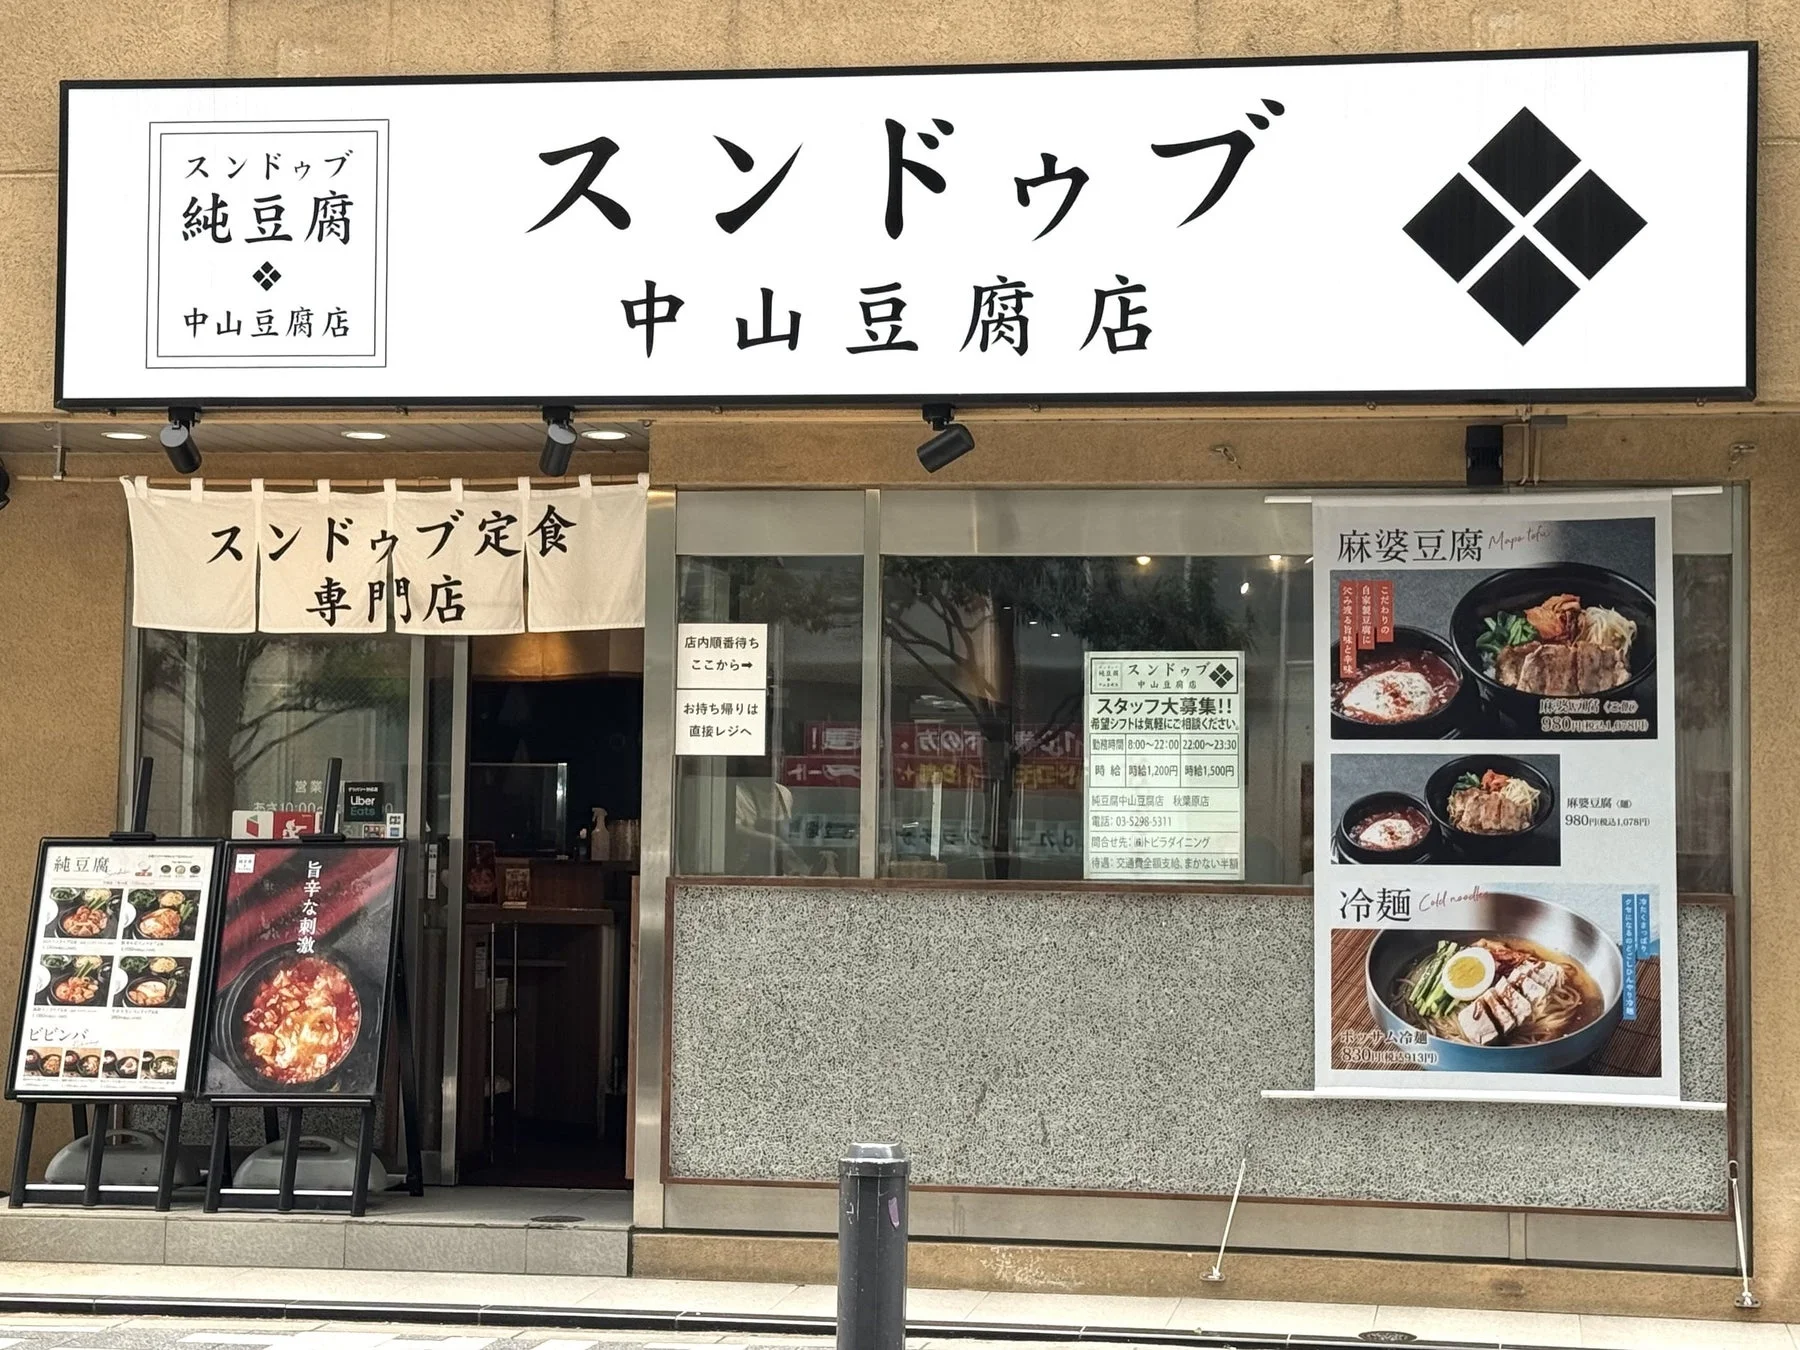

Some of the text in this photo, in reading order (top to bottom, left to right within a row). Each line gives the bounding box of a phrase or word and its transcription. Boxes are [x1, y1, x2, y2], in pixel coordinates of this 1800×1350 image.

[185, 149, 353, 181] スンドゥブ
[526, 98, 1285, 242] スンドゥブ
[182, 190, 353, 246] 純豆腐
[183, 305, 351, 340] 中山豆腐店
[620, 273, 1154, 359] 中山豆腐店
[206, 504, 577, 565] スンドゥブ定食
[1337, 528, 1484, 563] 麻婆豆腐
[305, 574, 467, 625] 専門店
[1380, 586, 1390, 634] こだわりの
[684, 636, 760, 649] 店内順番待ち
[691, 659, 740, 671] ここから
[1127, 661, 1211, 677] スンドゥブ
[683, 702, 759, 715] お持ち帰りは
[1096, 697, 1232, 716] スタッフ大募集!!
[689, 724, 752, 738] 直接レジへ
[1184, 764, 1235, 778] 時給1,500円
[350, 795, 375, 806] Uber
[350, 807, 375, 816] Eats
[53, 855, 109, 873] 純豆腐
[296, 860, 322, 954] 旨辛な刺激
[1340, 887, 1412, 923] 冷麺
[29, 1028, 89, 1042] ビビンバ
